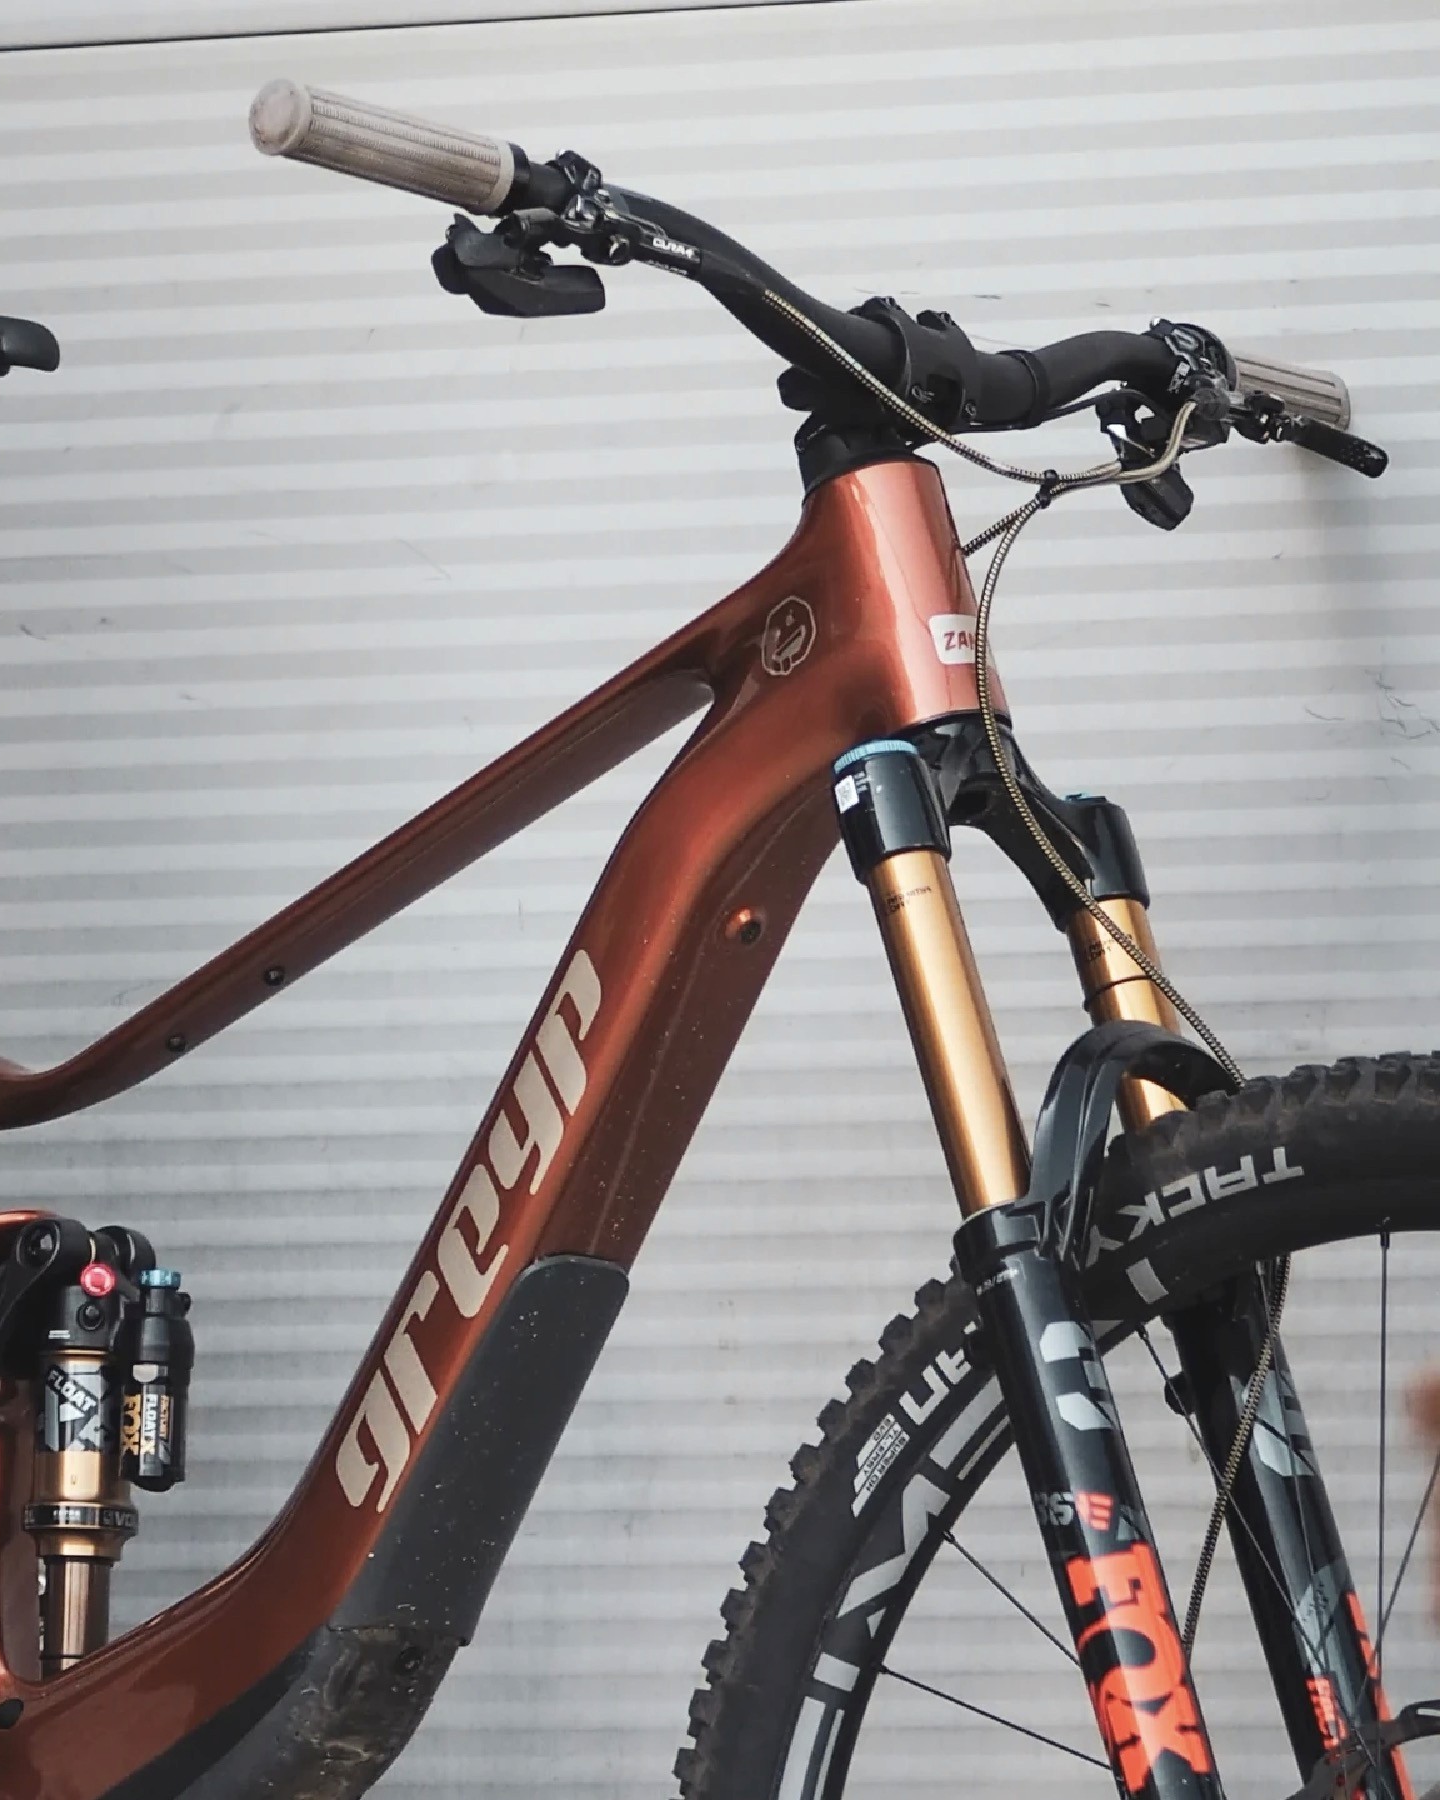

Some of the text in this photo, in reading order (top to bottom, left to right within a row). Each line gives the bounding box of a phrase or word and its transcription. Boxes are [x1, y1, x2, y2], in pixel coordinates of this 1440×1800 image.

[336, 949, 602, 1514] greyp
[1084, 1146, 1305, 1269] TACKY
[1065, 1542, 1211, 1793] FOX
